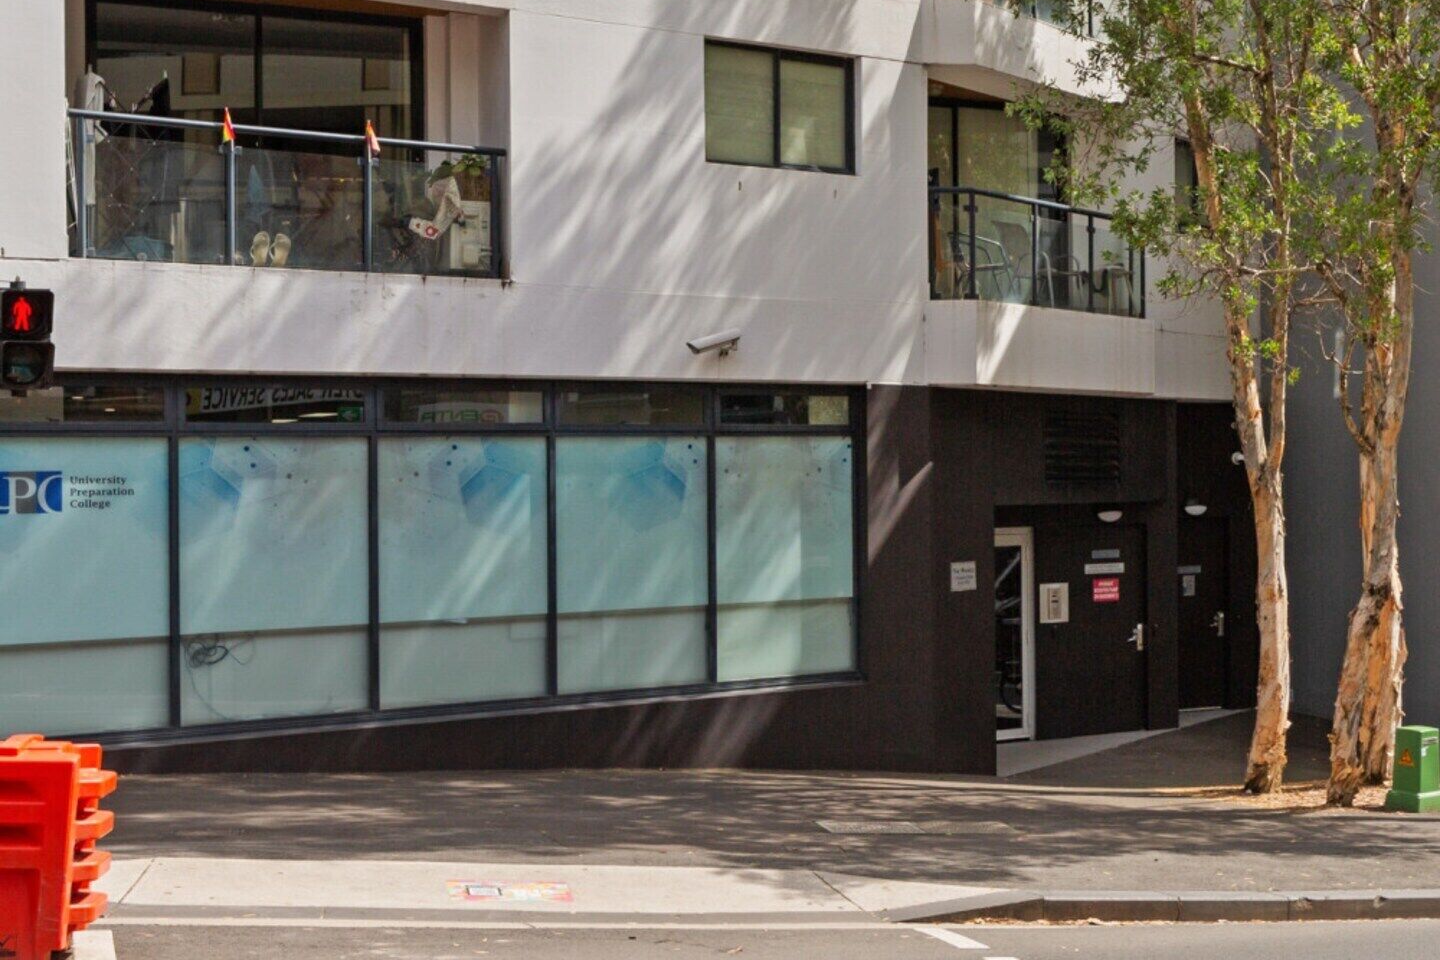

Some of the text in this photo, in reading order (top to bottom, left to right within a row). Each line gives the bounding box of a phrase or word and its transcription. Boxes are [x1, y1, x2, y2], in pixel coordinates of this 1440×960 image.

[69, 475, 127, 485] University
[69, 487, 135, 498] Preparation
[69, 499, 111, 509] College
